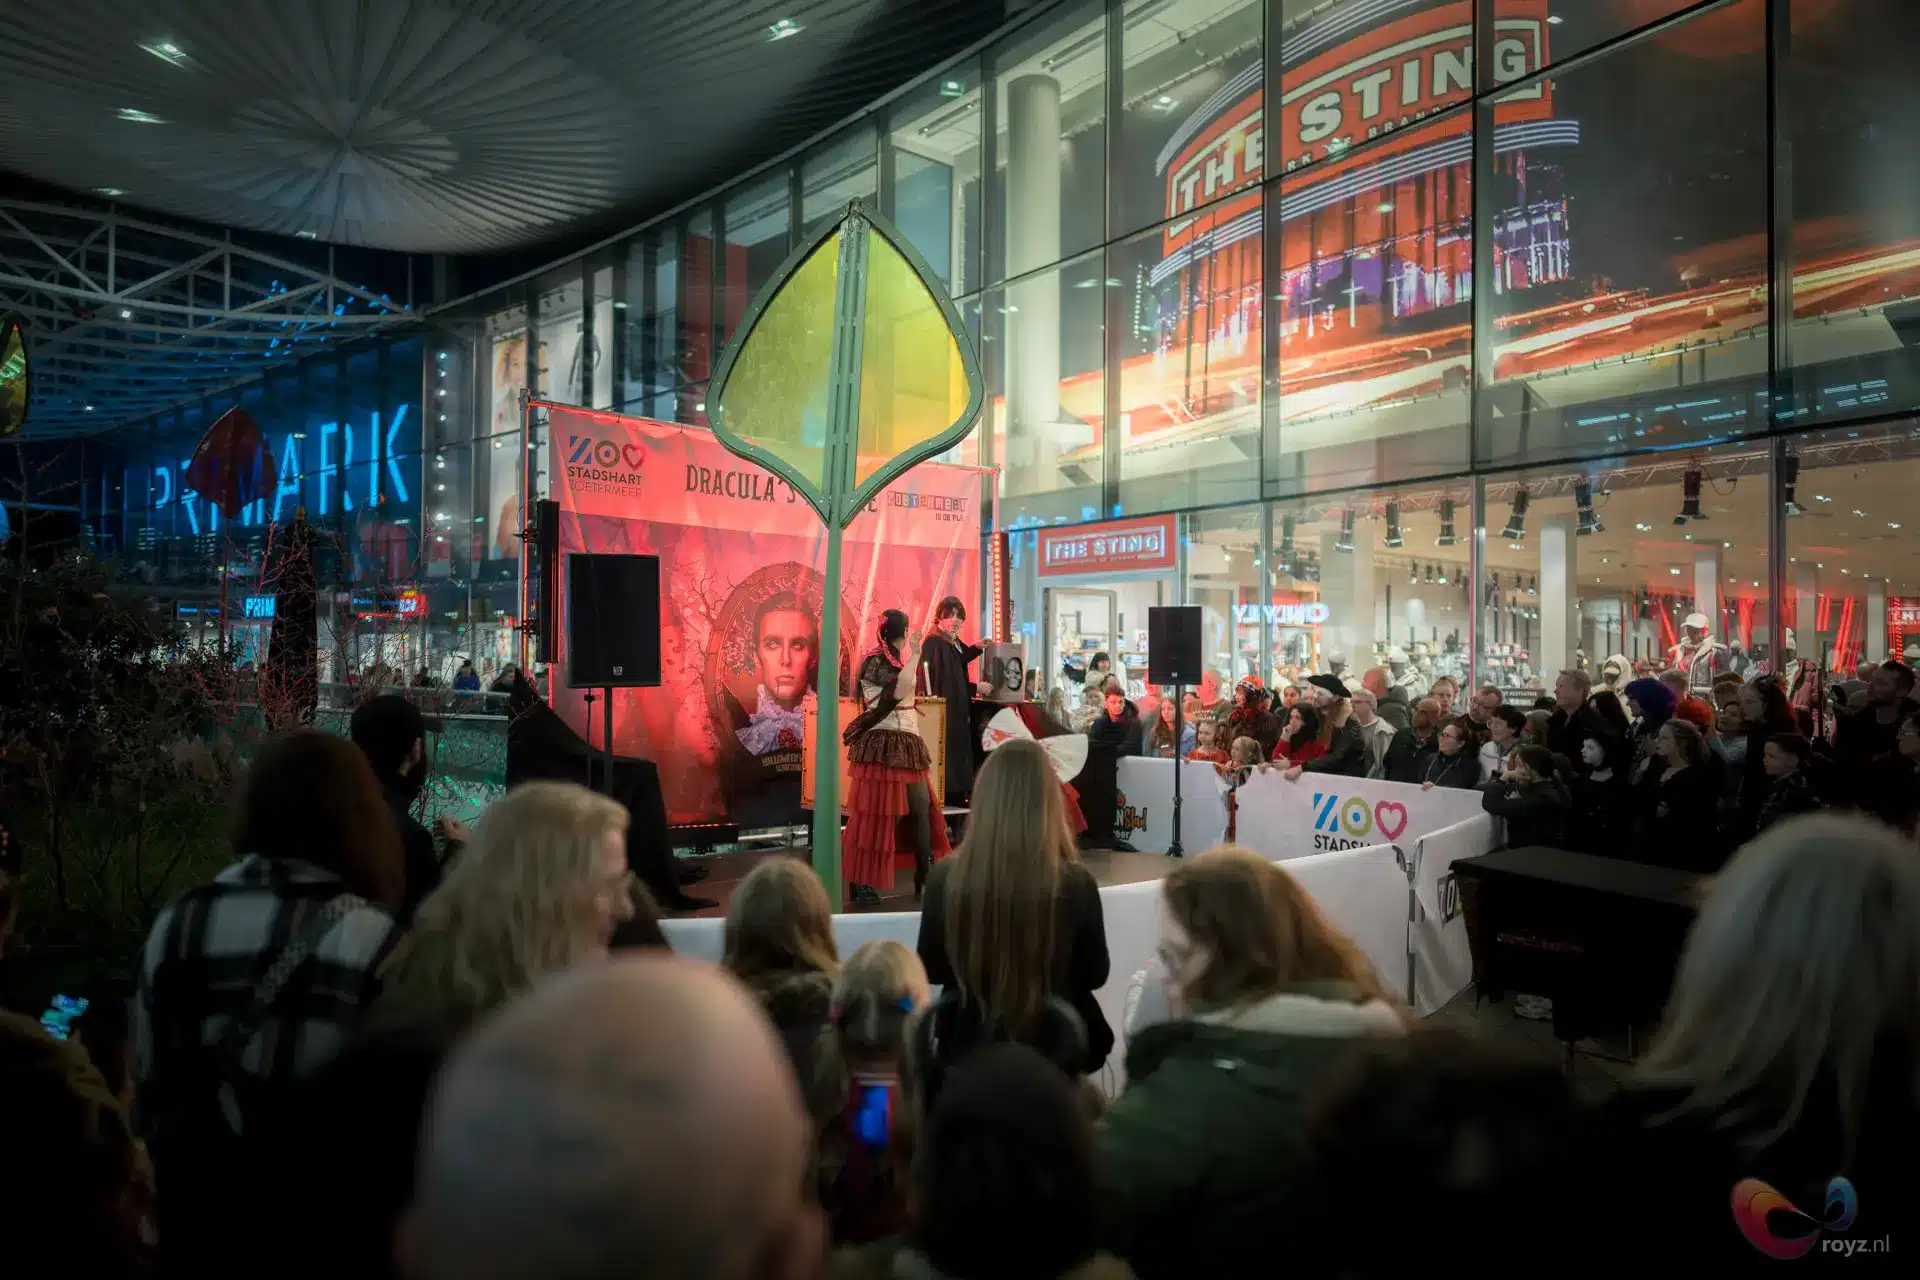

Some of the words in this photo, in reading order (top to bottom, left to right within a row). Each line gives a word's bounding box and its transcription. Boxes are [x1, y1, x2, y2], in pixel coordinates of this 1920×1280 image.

[1179, 126, 1263, 213] THE
[1300, 38, 1528, 143] STING
[568, 466, 642, 486] STADSHART
[685, 464, 796, 504] DRACULA'S
[568, 480, 642, 498] ZOETERMEER
[1052, 540, 1088, 559] THE
[1093, 534, 1159, 555] STING
